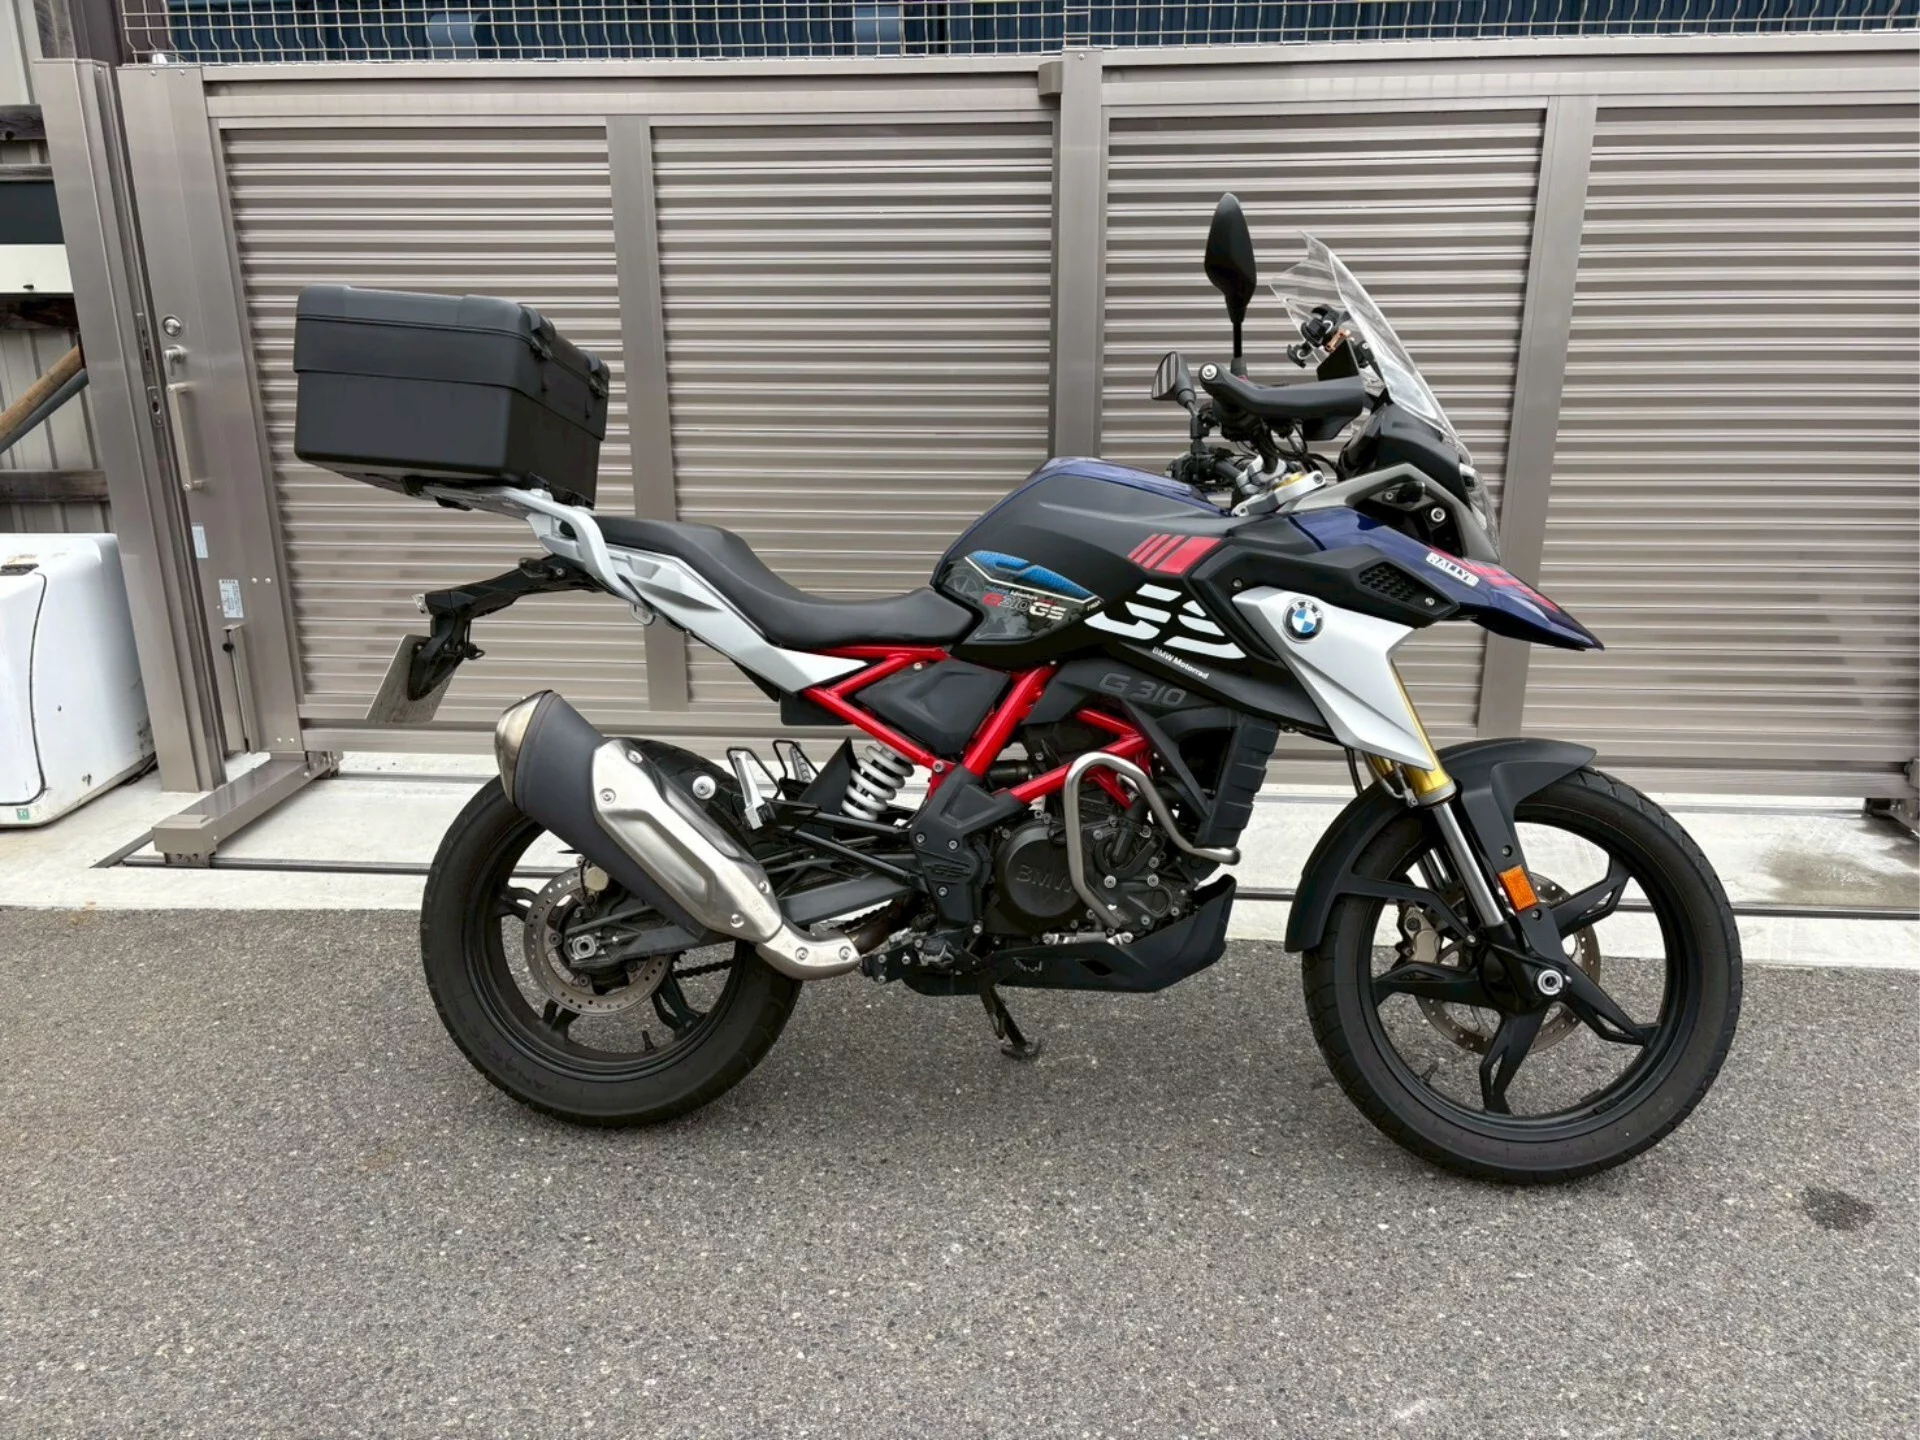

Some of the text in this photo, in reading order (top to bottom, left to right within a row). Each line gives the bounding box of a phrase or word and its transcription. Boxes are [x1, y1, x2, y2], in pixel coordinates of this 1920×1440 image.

[1152, 646, 1210, 680] BMW Motorrad
[1100, 672, 1187, 706] G 310
